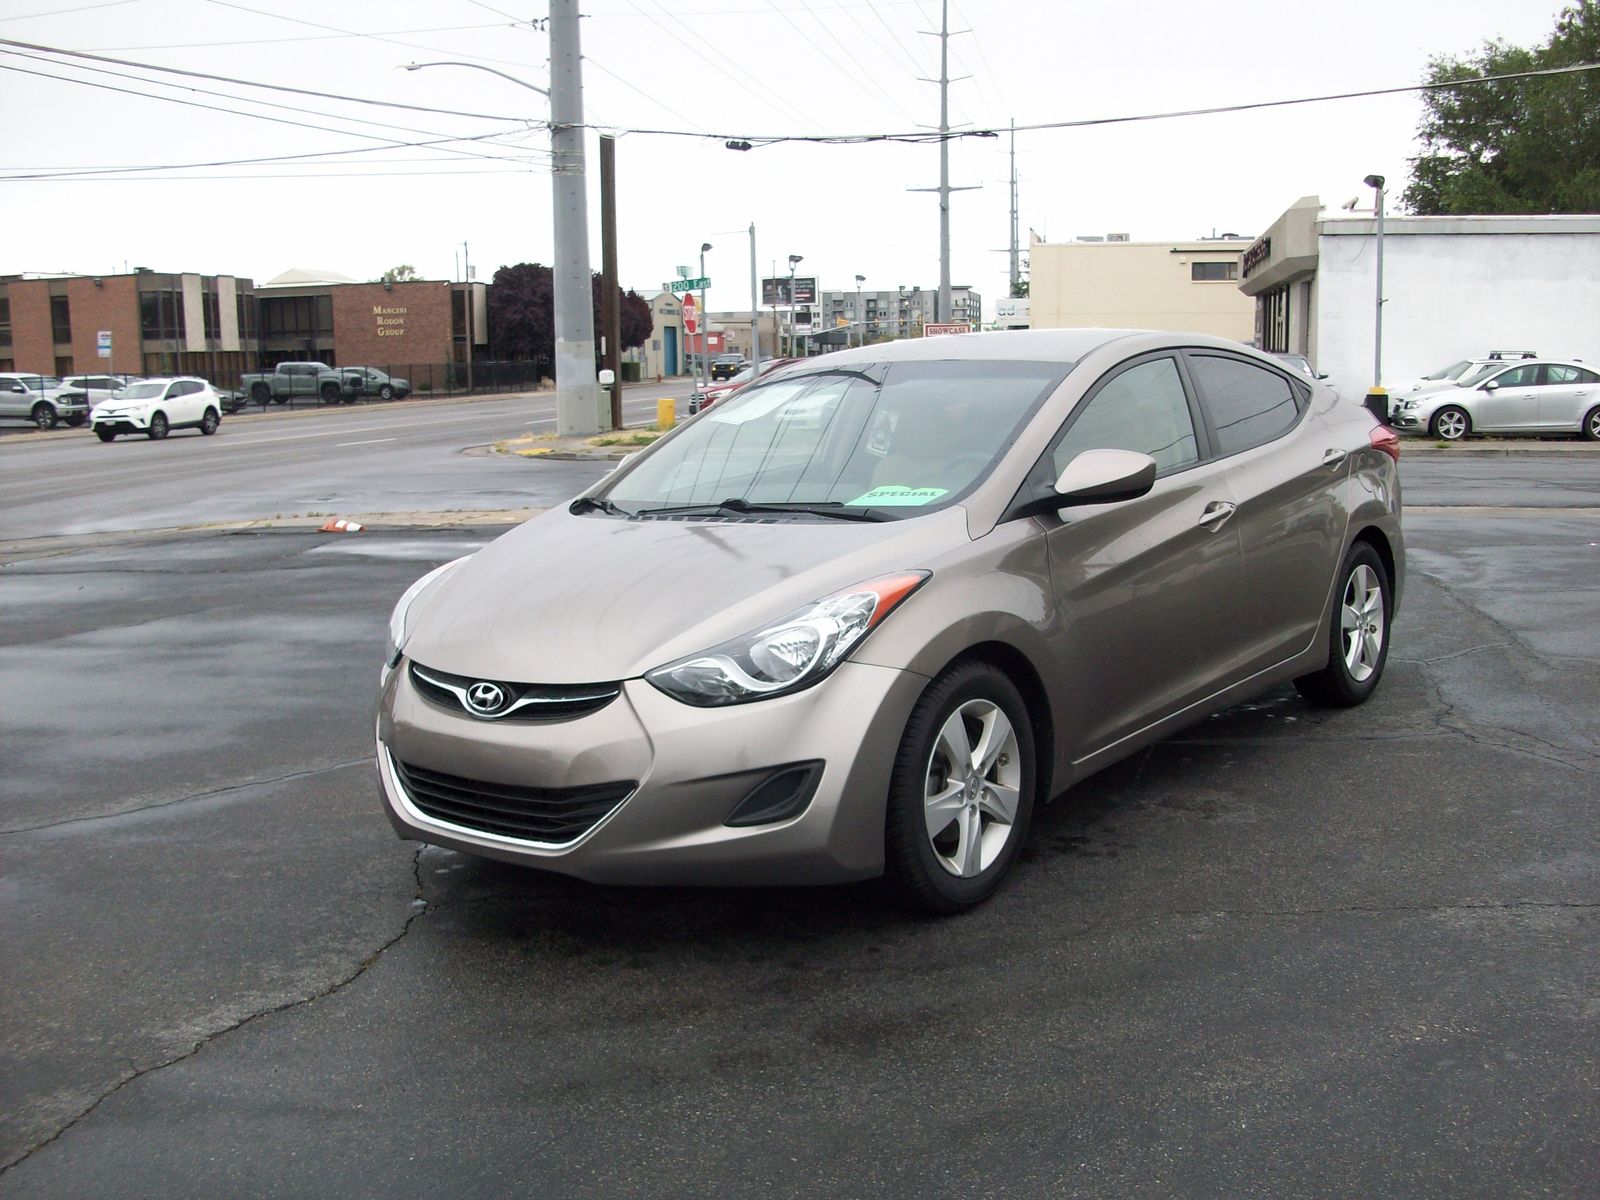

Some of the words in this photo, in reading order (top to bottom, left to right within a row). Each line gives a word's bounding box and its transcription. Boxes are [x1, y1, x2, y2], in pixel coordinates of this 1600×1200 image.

[672, 282, 689, 292] 200
[693, 279, 711, 289] East
[929, 327, 966, 335] SHOWCASE
